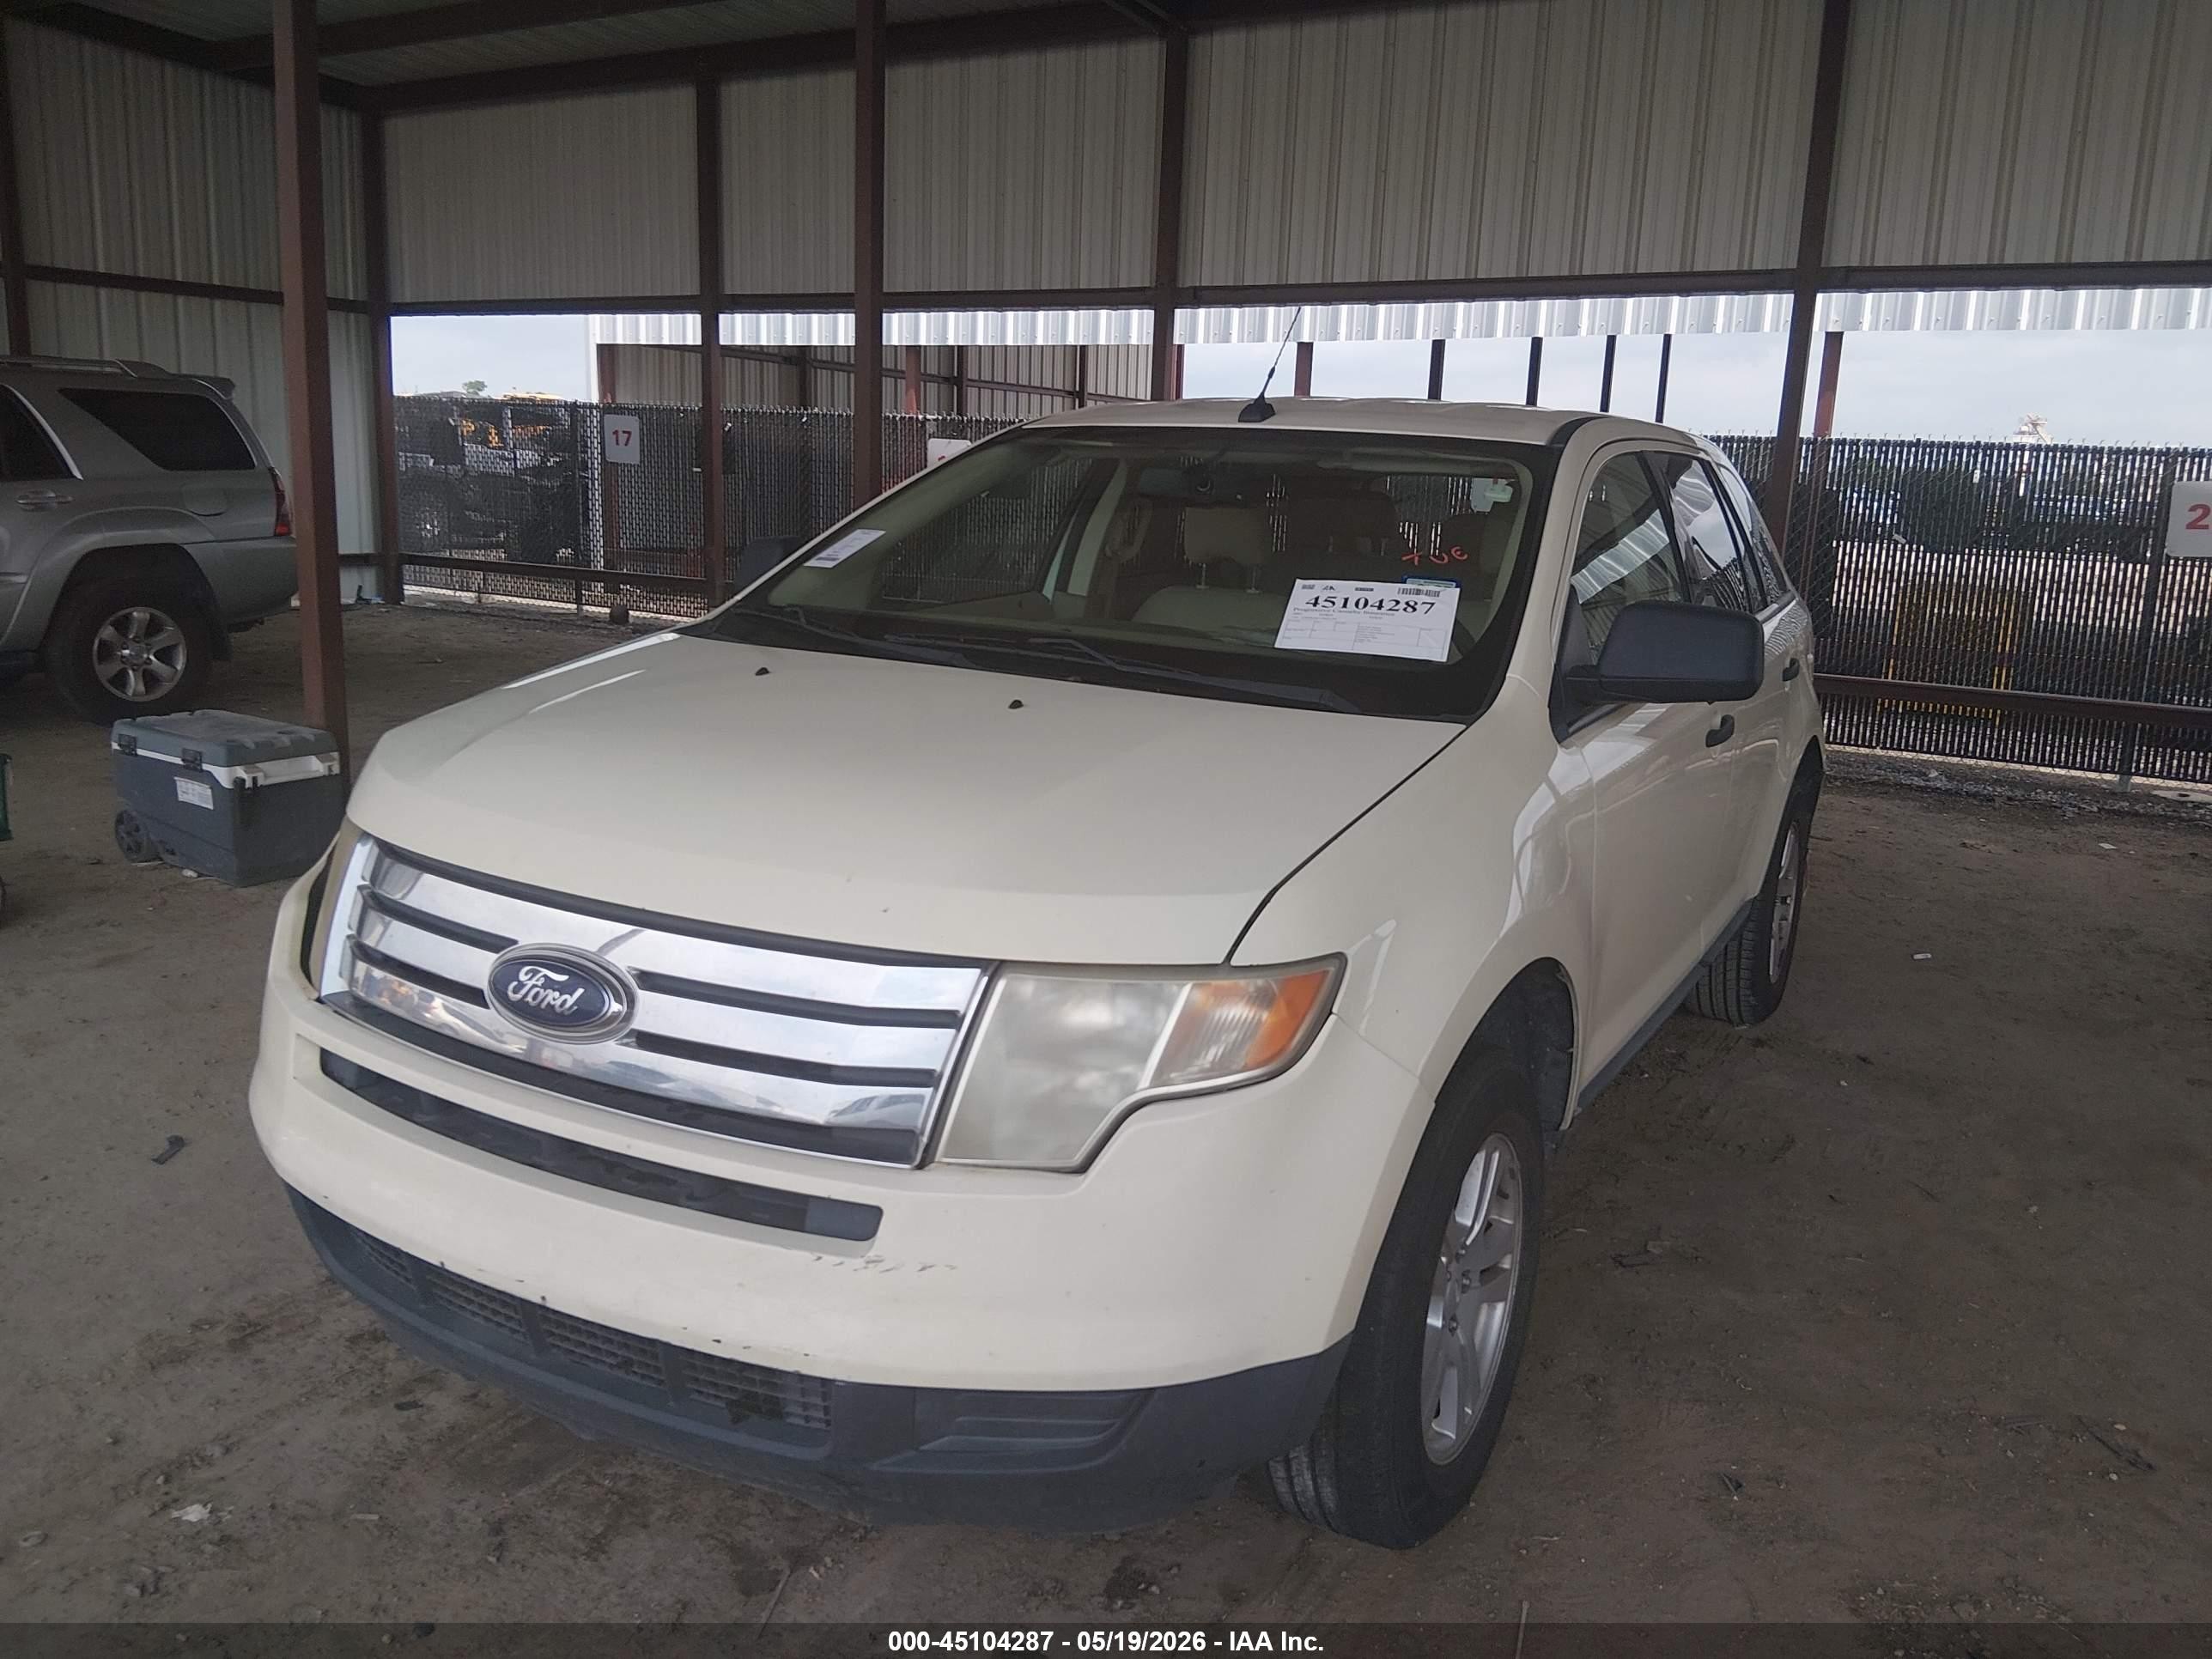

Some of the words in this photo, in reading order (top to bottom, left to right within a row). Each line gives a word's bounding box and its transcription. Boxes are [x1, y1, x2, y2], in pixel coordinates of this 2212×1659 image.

[612, 429, 632, 446] 17
[1305, 595, 1437, 615] 45104287
[507, 965, 586, 1015] Ford
